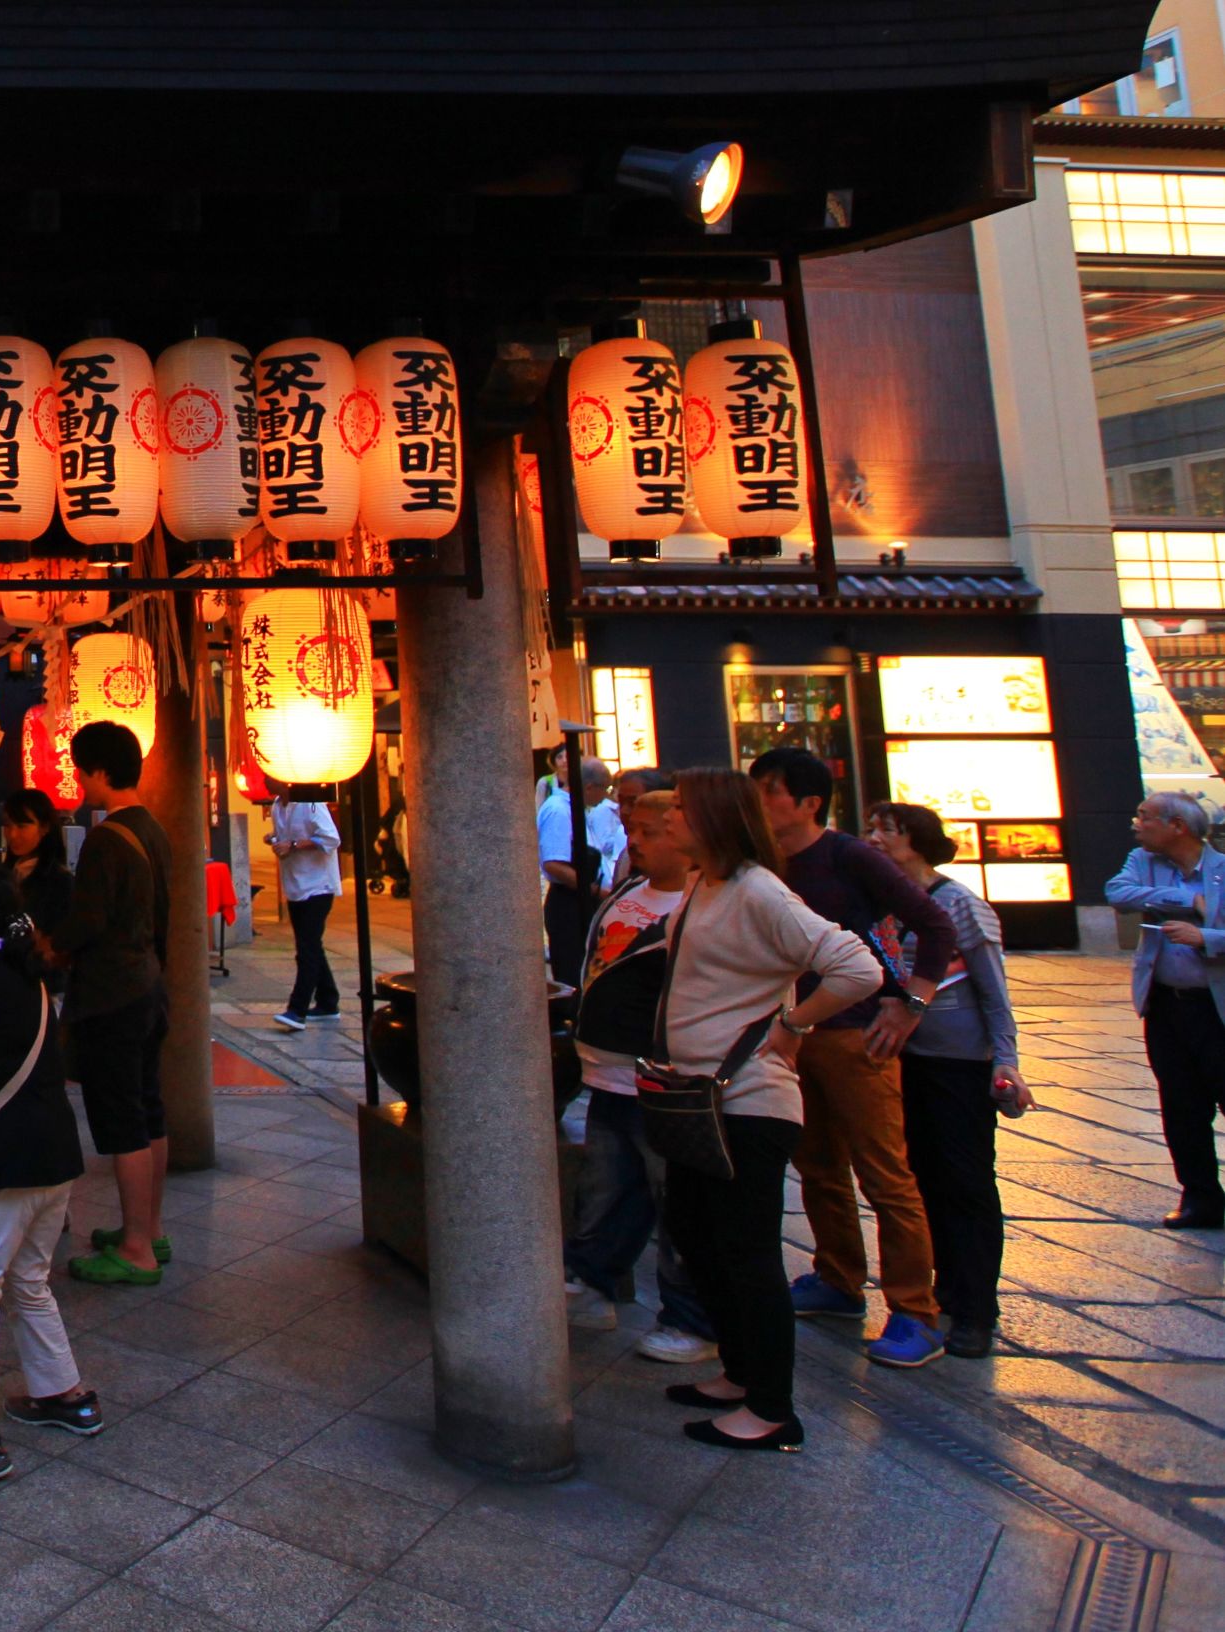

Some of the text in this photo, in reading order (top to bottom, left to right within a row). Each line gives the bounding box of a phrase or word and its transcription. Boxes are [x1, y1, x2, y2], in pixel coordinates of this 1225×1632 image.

[57, 355, 120, 520] 不動明王
[259, 352, 328, 518] 不動明王
[393, 351, 457, 512] 不動明王
[623, 355, 686, 516] 不動明王
[725, 354, 799, 512] 不動明王
[251, 614, 276, 709] 株式会社
